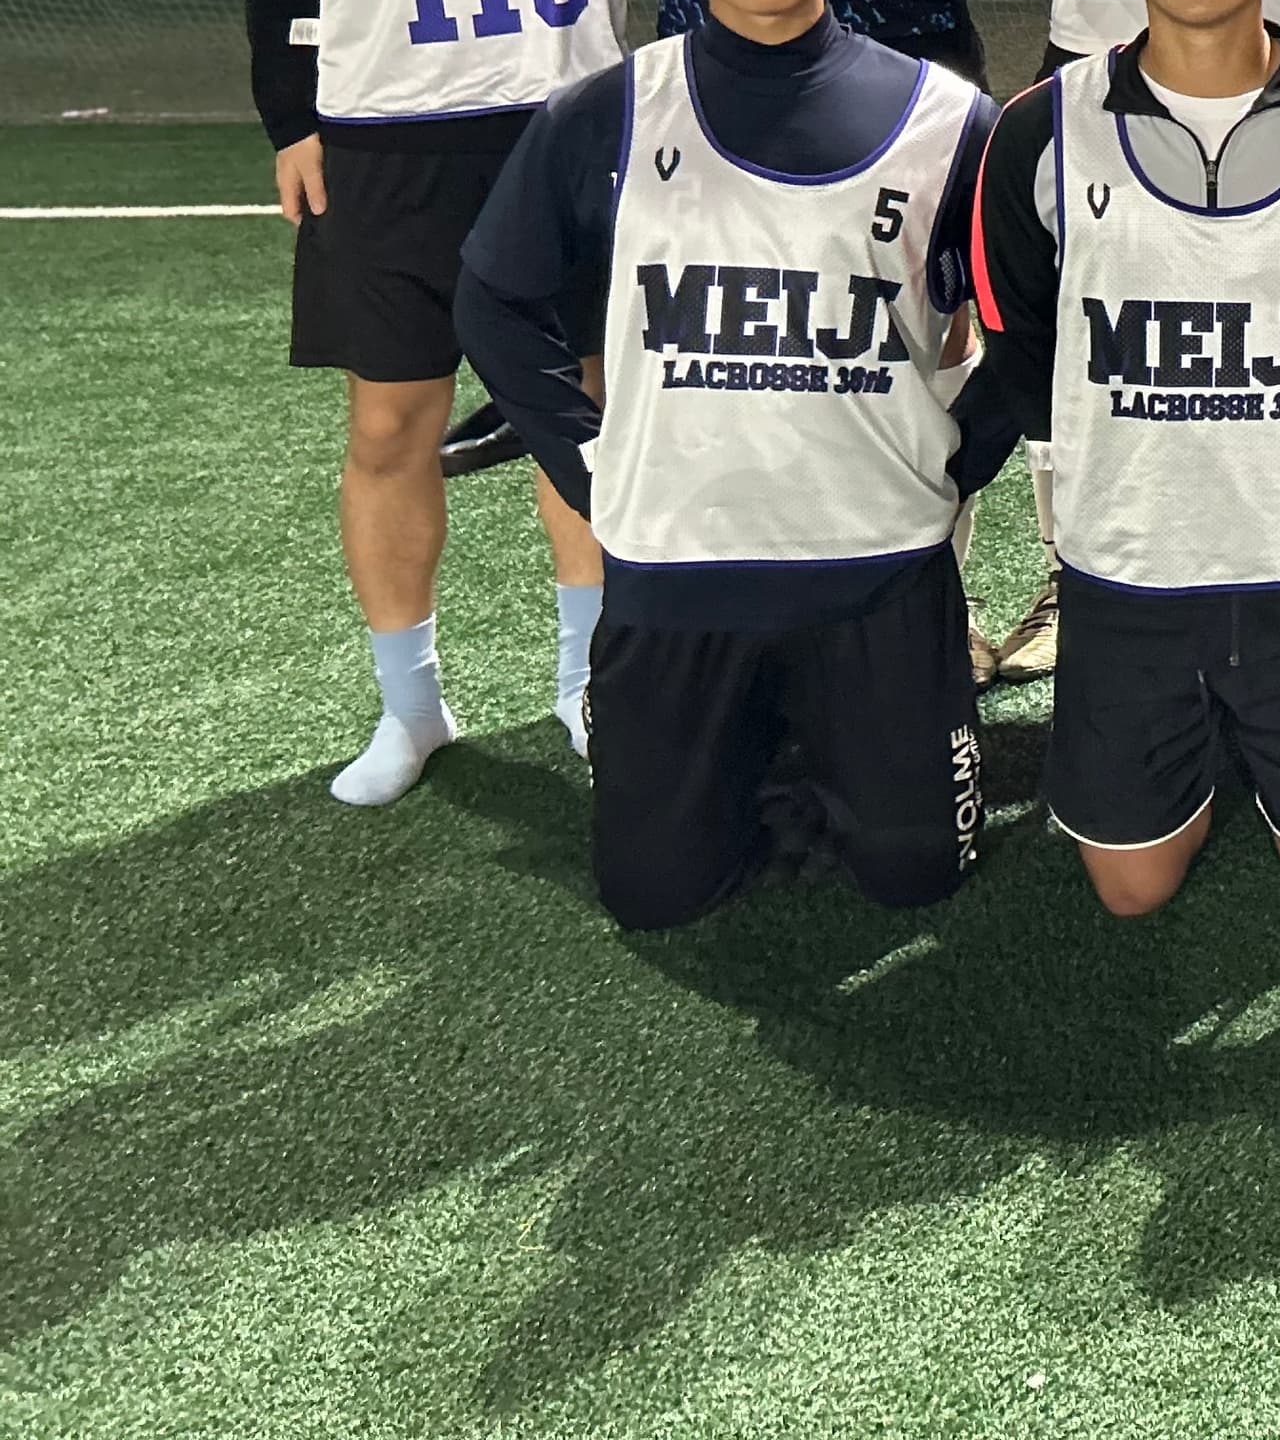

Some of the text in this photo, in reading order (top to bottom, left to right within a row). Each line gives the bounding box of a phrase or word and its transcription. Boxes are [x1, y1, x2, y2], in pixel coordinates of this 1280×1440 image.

[871, 187, 910, 243] 5
[637, 263, 910, 361] MEIJI
[662, 359, 829, 392] LACROSSE
[1110, 390, 1264, 422] LACROSSE
